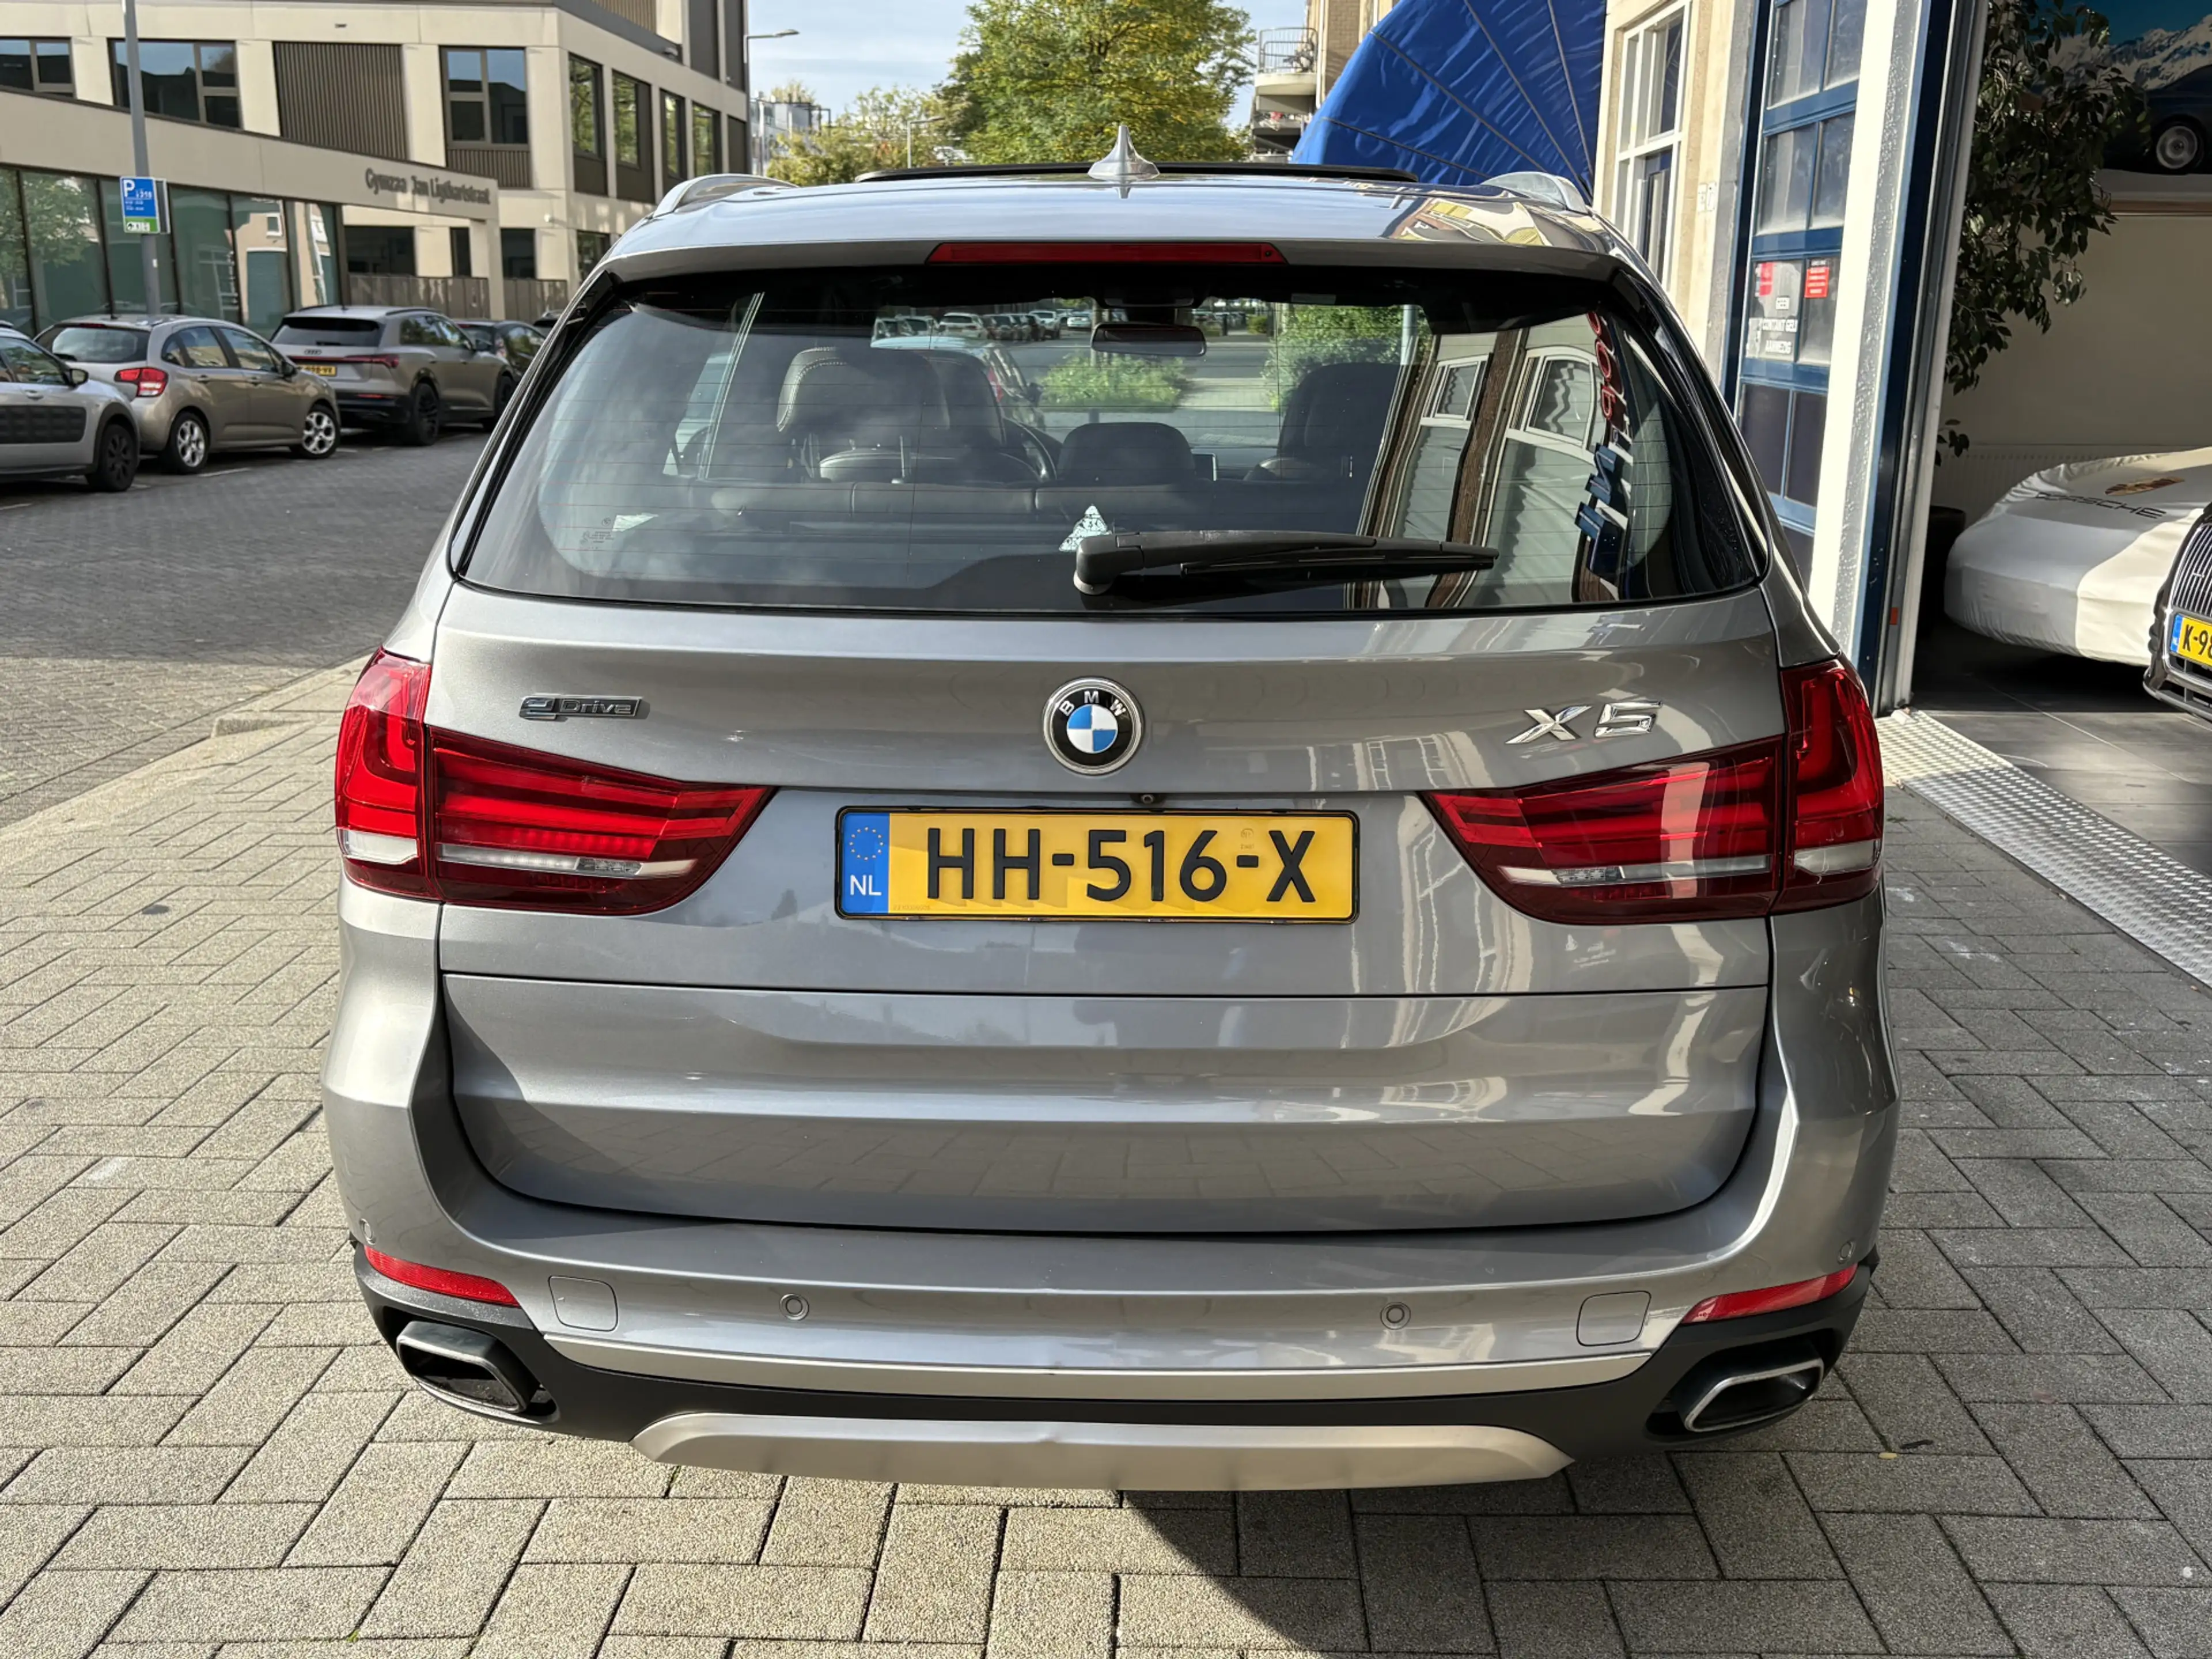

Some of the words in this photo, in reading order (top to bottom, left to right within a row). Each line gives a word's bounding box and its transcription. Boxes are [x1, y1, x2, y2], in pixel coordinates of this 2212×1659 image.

[123, 180, 135, 197] P
[2035, 491, 2166, 519] PORSCHE
[2183, 624, 2212, 660] K-9
[519, 695, 632, 720] eDrive
[1059, 691, 1127, 717] BMW
[1505, 701, 1662, 744] X5
[927, 828, 1315, 903] HH-516-X
[850, 874, 882, 897] NL
